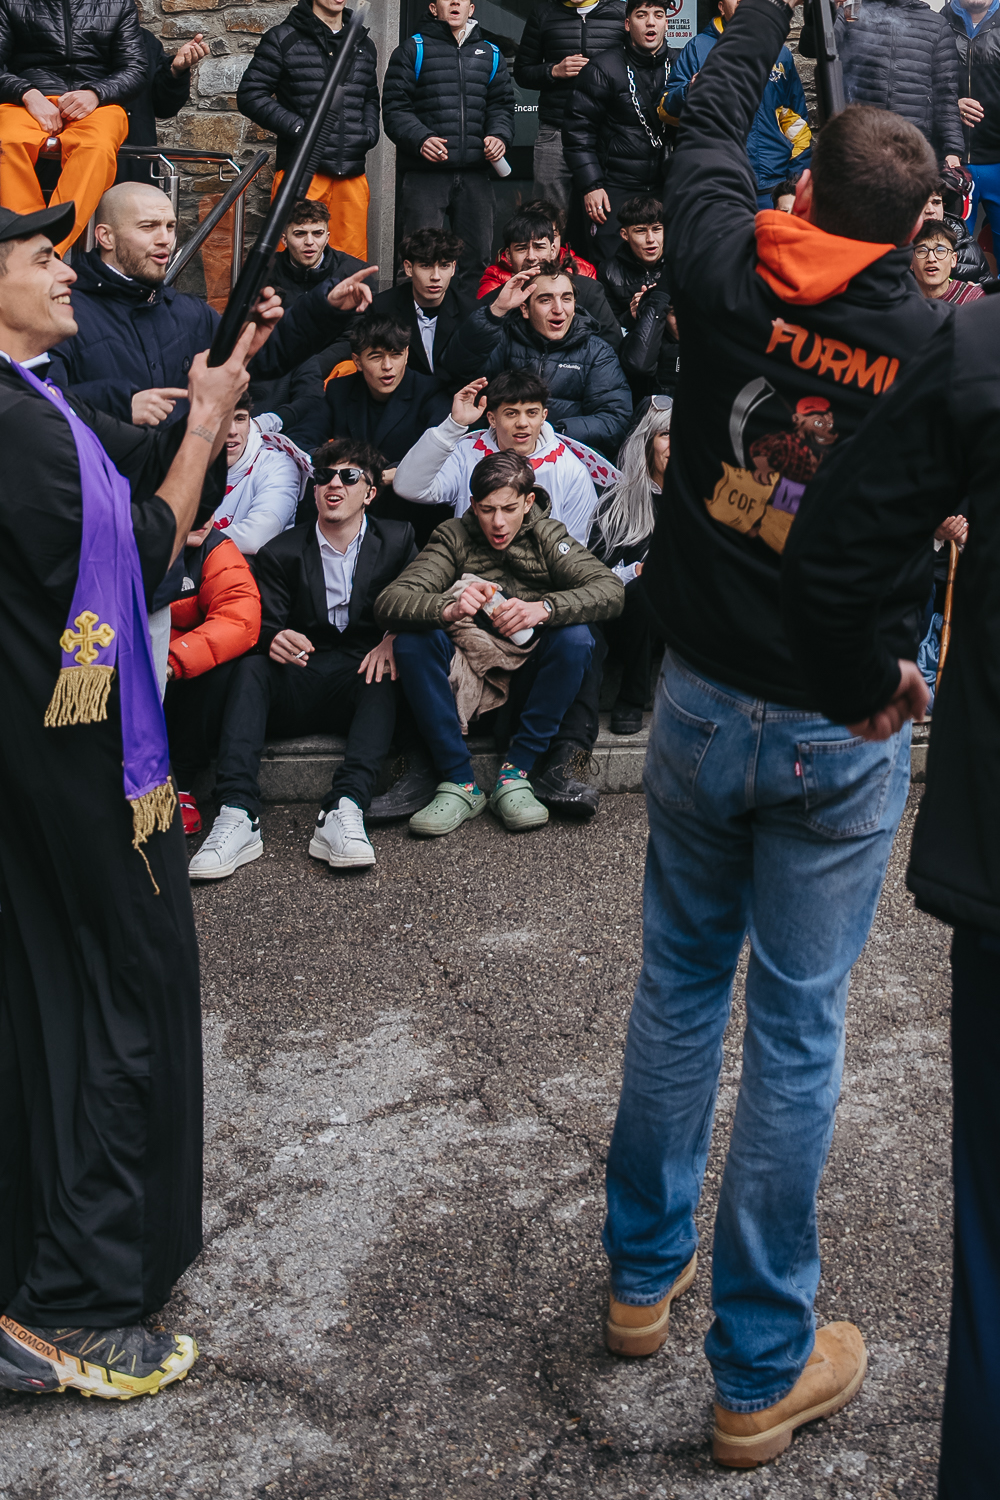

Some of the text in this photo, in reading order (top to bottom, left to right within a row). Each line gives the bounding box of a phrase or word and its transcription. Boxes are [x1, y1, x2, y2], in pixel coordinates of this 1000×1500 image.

[765, 317, 900, 396] FURMI
[728, 488, 757, 515] CDF
[1, 1317, 55, 1356] SALOMON
